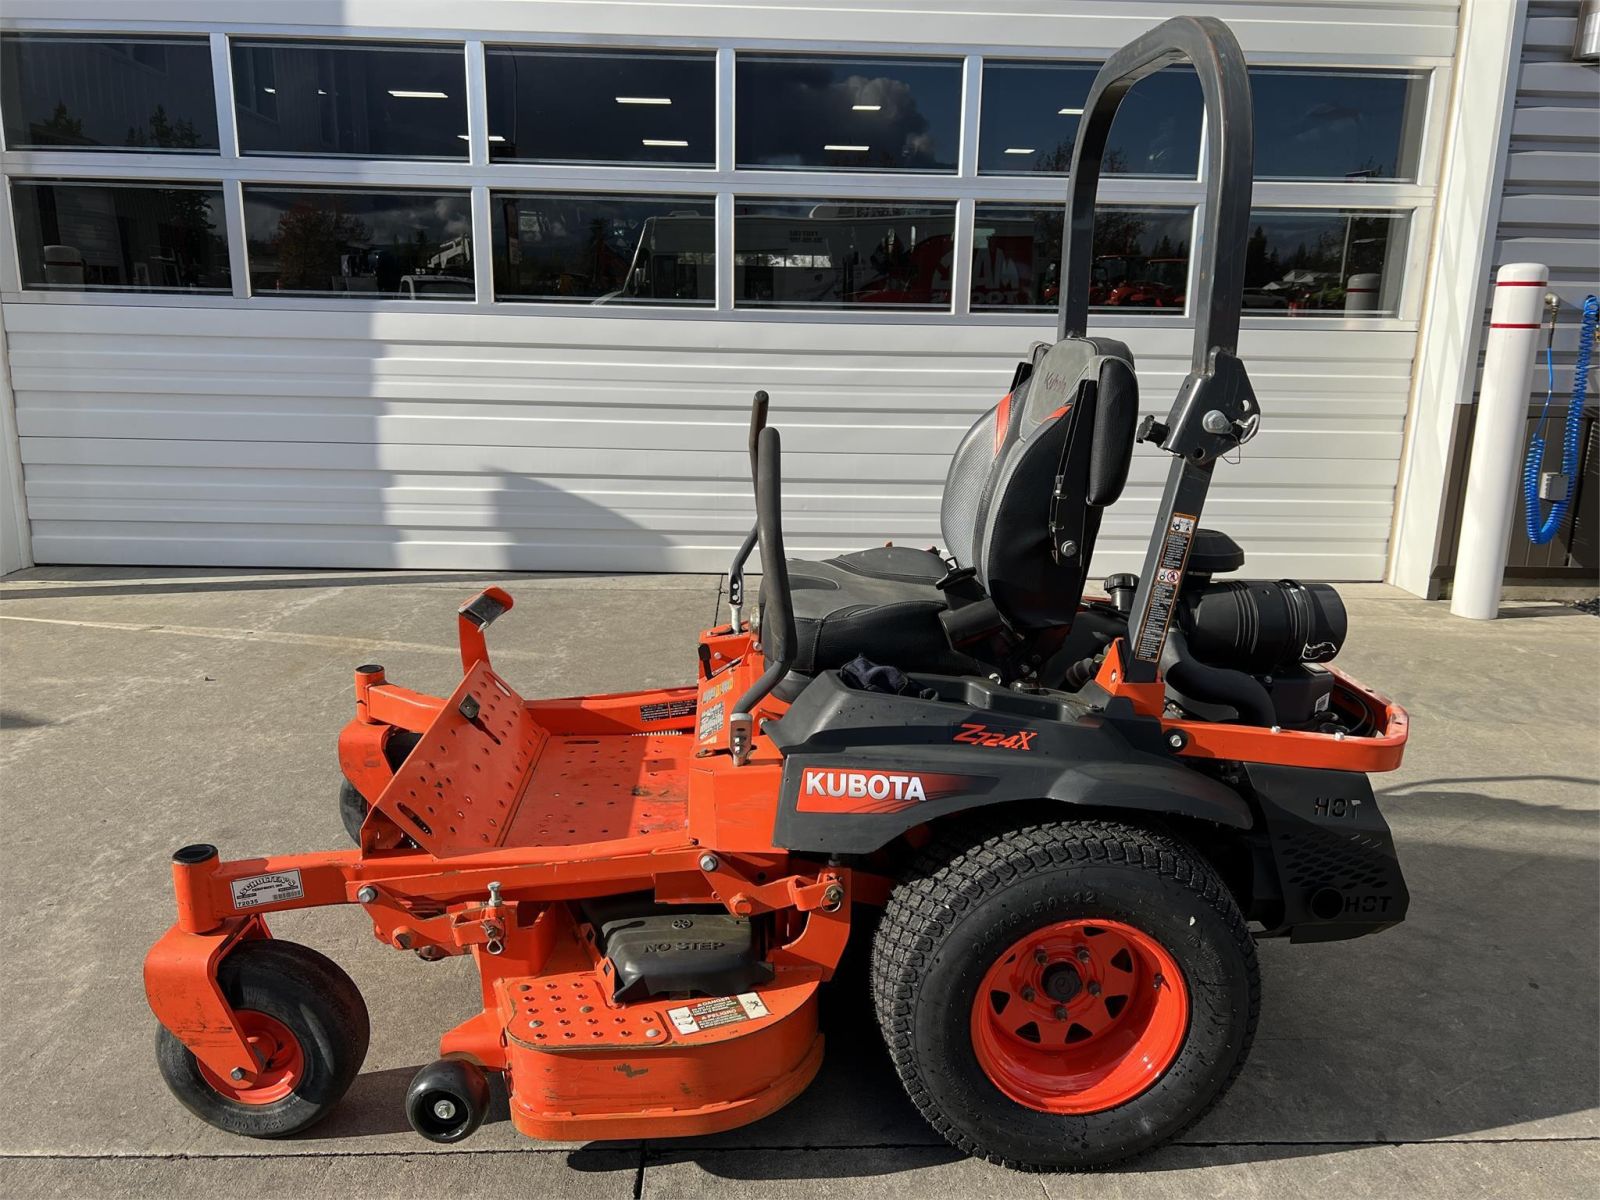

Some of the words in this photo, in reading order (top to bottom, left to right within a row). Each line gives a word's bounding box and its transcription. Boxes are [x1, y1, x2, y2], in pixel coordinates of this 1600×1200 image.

[953, 723, 1038, 751] Z724X
[805, 771, 928, 802] KUBOTA
[1314, 797, 1361, 820] HOT
[1344, 896, 1392, 912] HOT
[644, 943, 672, 953] NO
[675, 941, 726, 951] STEP
[702, 996, 731, 1006] DANGER
